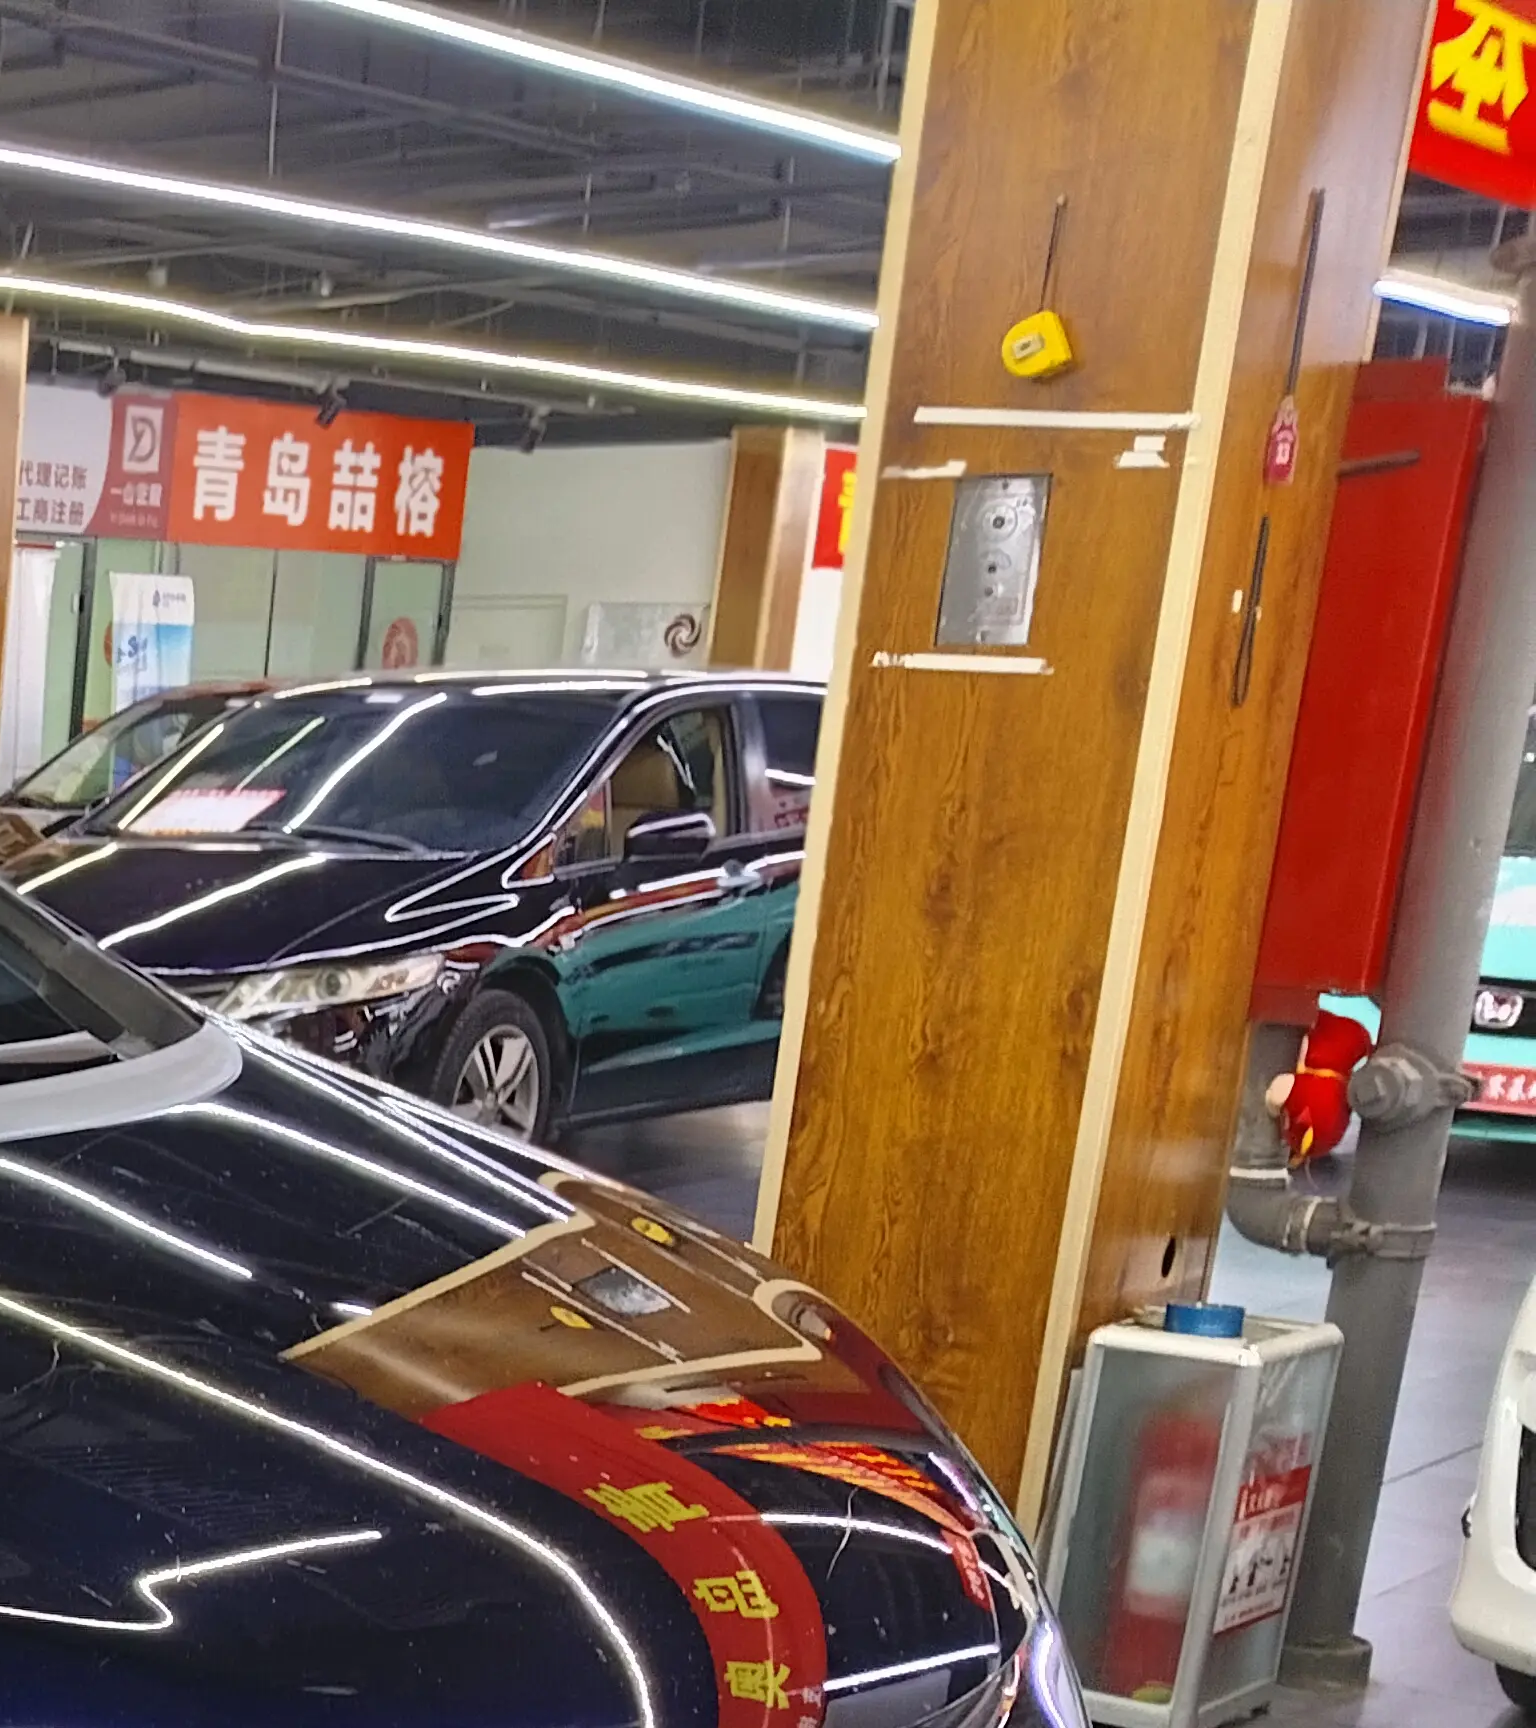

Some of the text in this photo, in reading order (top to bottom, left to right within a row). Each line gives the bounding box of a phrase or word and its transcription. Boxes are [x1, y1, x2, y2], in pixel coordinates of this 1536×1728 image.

[16, 497, 84, 526] 工商注册
[192, 424, 445, 540] 青岛喆榕
